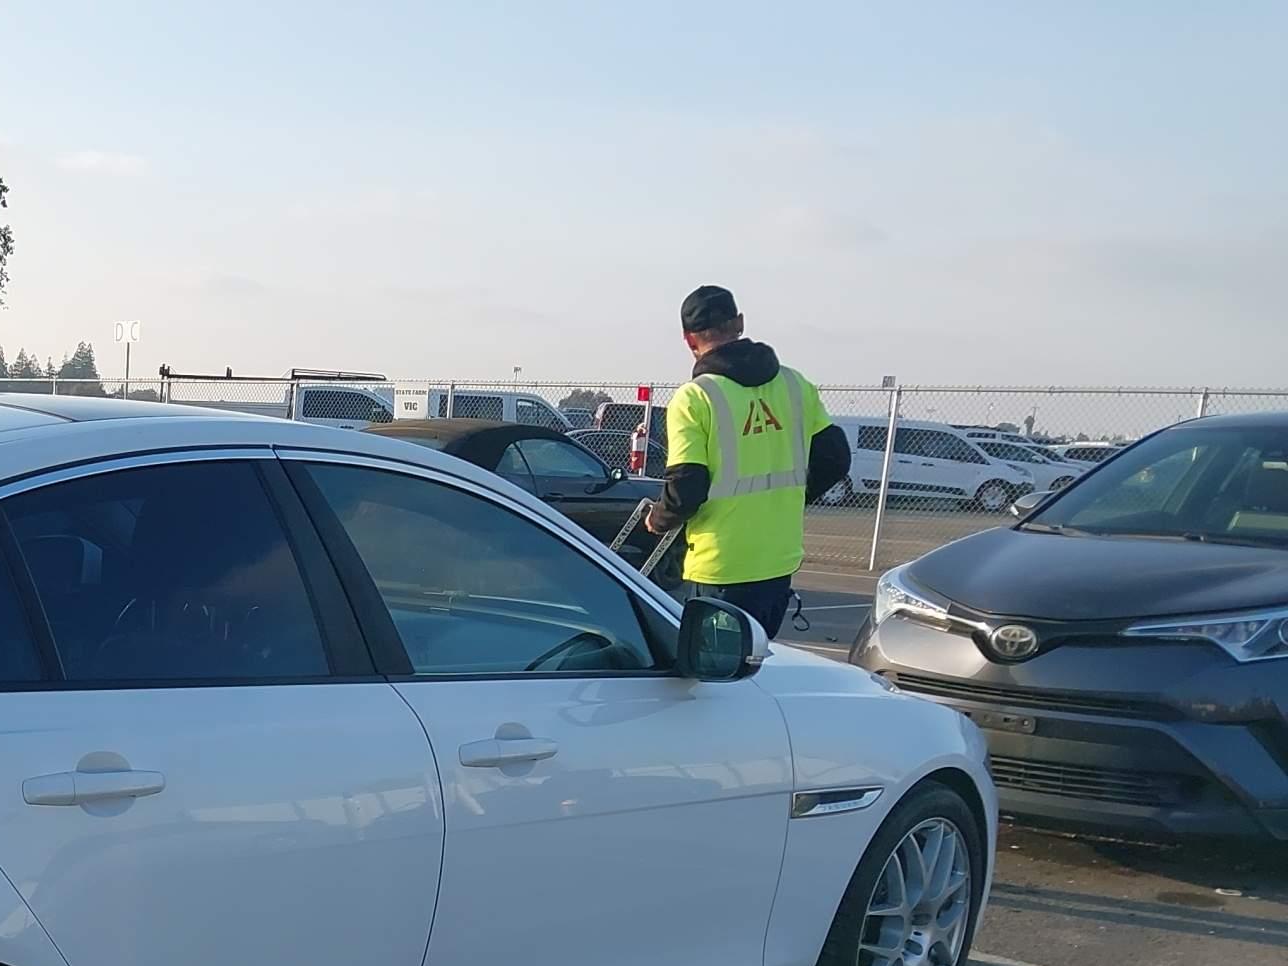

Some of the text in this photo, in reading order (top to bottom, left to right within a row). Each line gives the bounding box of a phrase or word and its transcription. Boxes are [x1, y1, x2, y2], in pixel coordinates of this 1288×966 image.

[115, 320, 139, 342] D C
[403, 401, 418, 411] VIC
